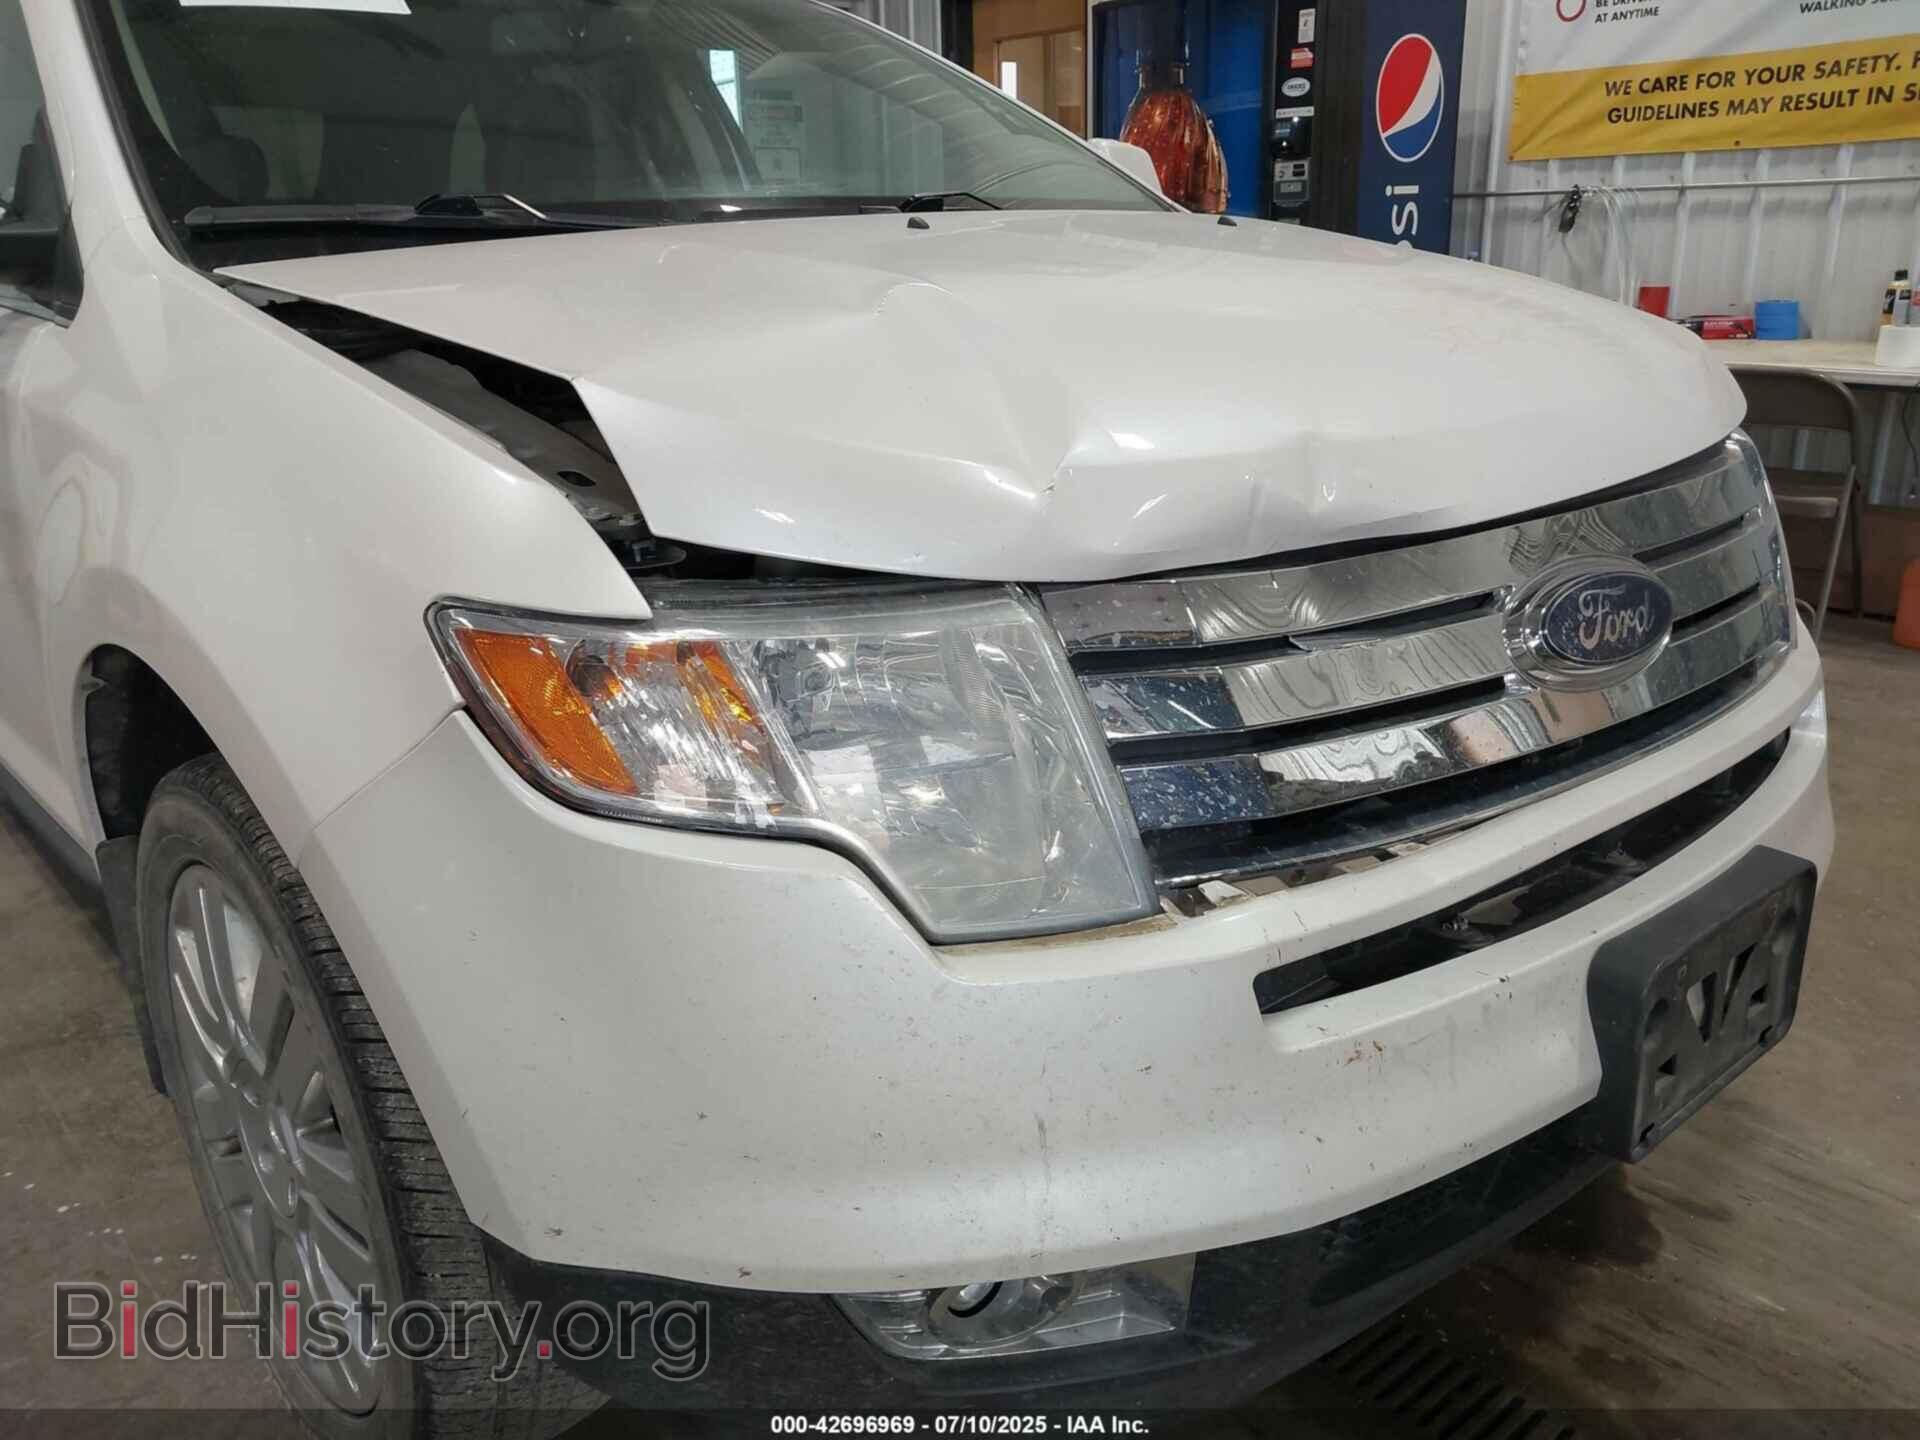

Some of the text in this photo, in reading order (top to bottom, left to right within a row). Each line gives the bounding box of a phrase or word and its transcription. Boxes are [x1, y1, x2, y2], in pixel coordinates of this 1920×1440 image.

[1594, 6, 1660, 24] AT ANYTIME
[1800, 0, 1866, 13] WALKING
[1605, 81, 1632, 97] WE
[1638, 75, 1689, 94] CARE
[1696, 71, 1736, 90] FOR
[1745, 64, 1805, 85] YOUR
[1814, 53, 1902, 80] SAFETY.
[1608, 82, 1920, 124] GUIDELINES MAY RESULT IN S
[1385, 184, 1419, 247] si
[1578, 583, 1655, 650] Ford
